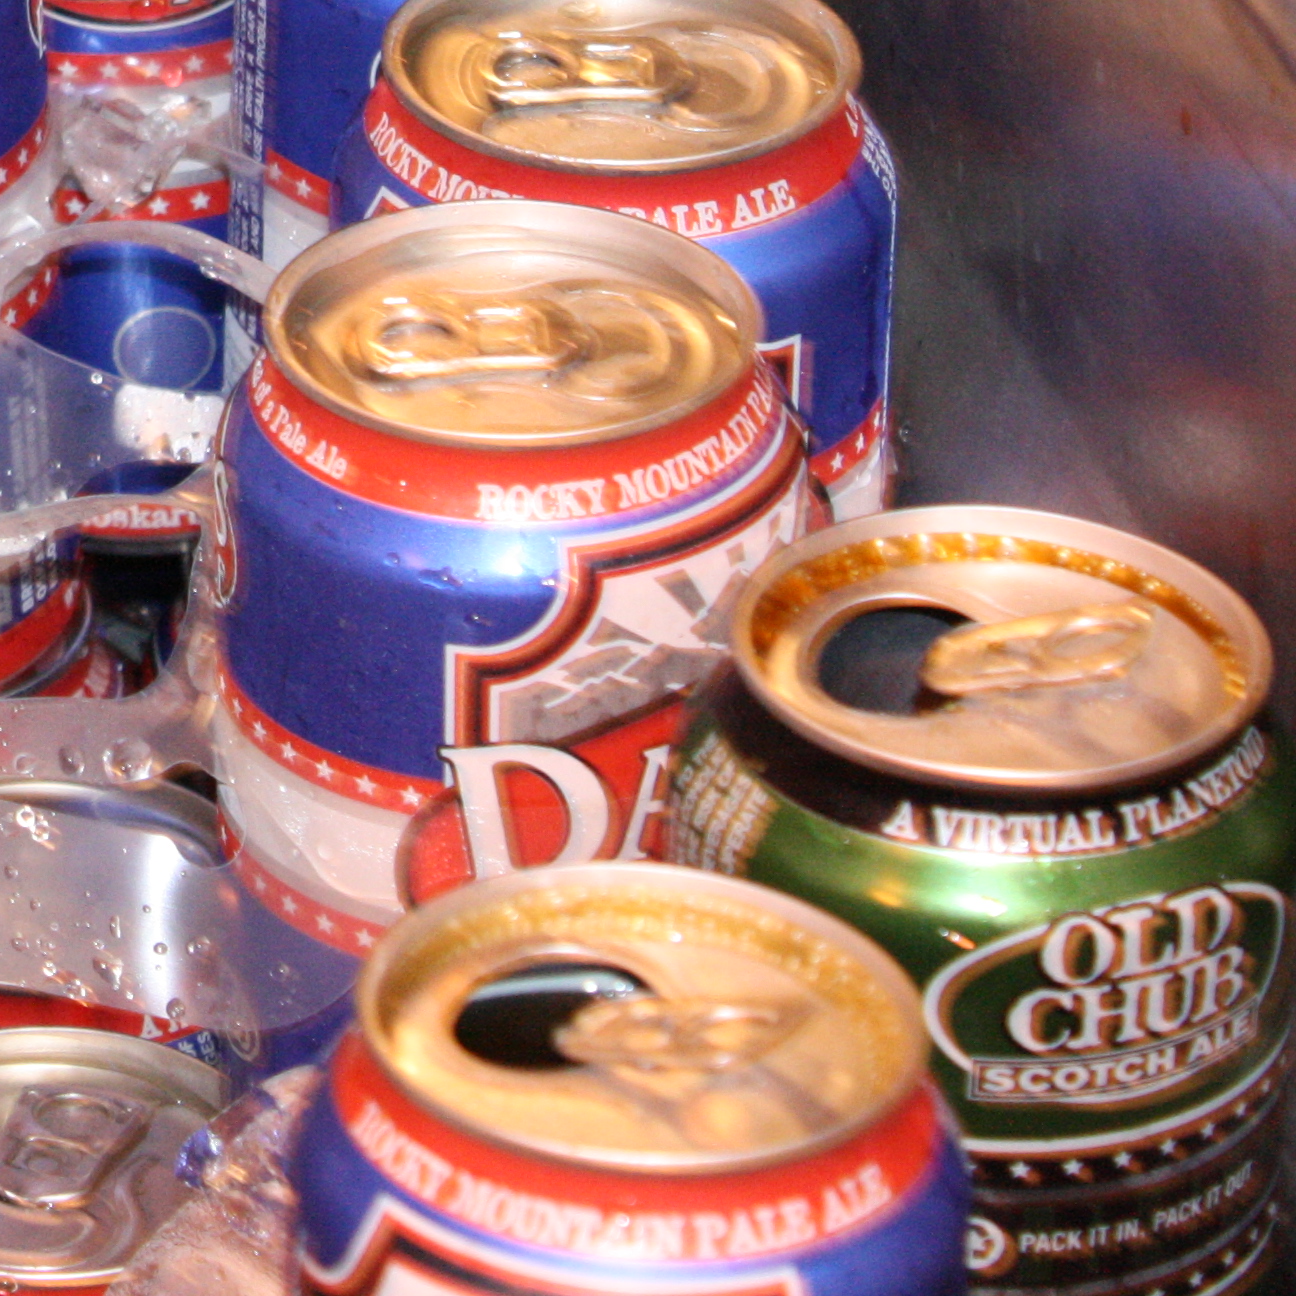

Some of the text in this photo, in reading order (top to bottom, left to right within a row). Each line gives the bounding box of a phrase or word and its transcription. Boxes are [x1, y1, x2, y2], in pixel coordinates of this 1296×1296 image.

[370, 112, 434, 189] ROCKY
[729, 178, 797, 227] ALE
[270, 405, 348, 479] Pale Ale
[474, 403, 759, 521] ROCKY MOUNTAIN
[882, 726, 1265, 853] A VIRTUAL PLANETOID
[1040, 888, 1233, 986] OLD
[983, 1012, 1249, 1093] SCOTCH ALE
[1010, 945, 1244, 1054] CHUB
[353, 1100, 892, 1259] ROCKY MOUNTAIN PALE ALE
[1019, 1230, 1083, 1252] PACK
[1089, 1228, 1111, 1248] IT
[1152, 1198, 1202, 1230] PACK
[1204, 1186, 1222, 1209] IT
[1223, 1161, 1254, 1196] OUT
